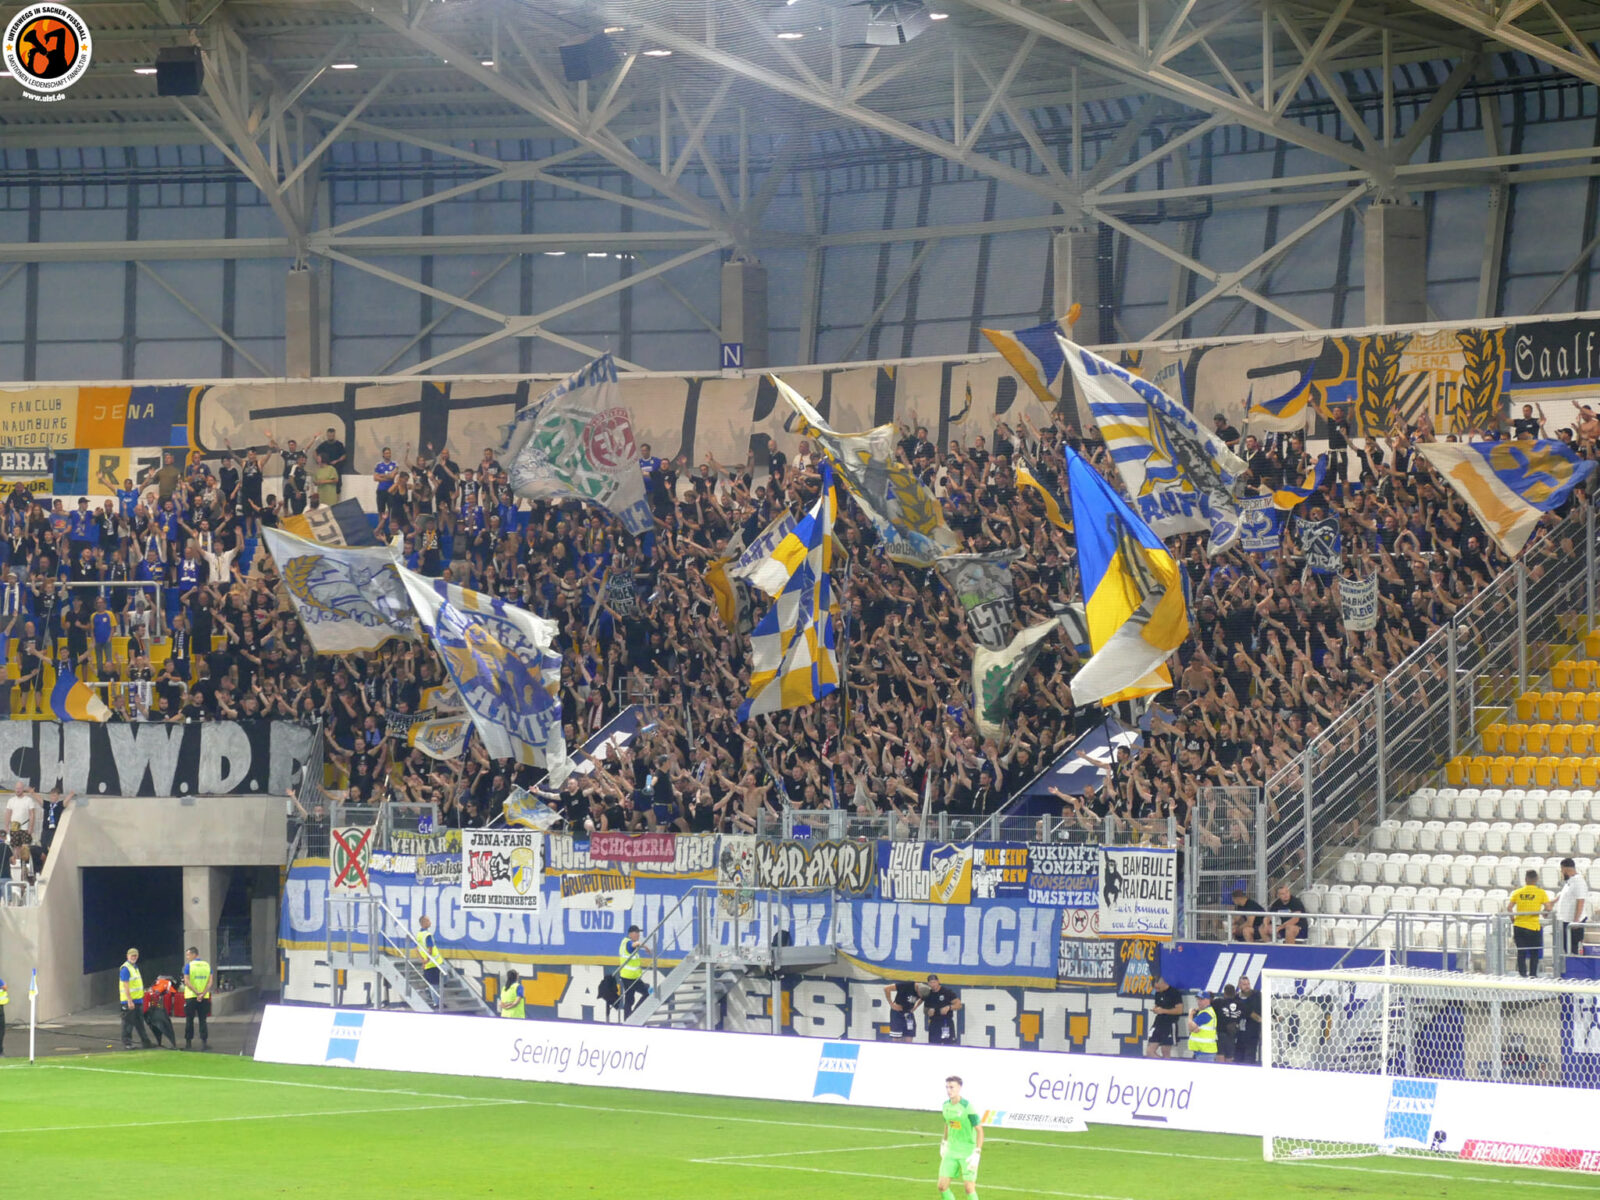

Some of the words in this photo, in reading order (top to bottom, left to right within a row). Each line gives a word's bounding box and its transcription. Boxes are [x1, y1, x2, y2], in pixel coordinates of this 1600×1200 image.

[724, 345, 741, 366] N
[1410, 354, 1450, 368] JENA
[1515, 331, 1600, 381] Saalf
[11, 400, 31, 414] FAN
[35, 398, 62, 411] CLUB
[1436, 381, 1456, 416] FC
[93, 402, 155, 421] JENA
[2, 417, 67, 432] NAUMBURG
[0, 433, 38, 447] UNITED
[40, 432, 68, 445] CITYS
[391, 837, 448, 855] WEIMAR
[471, 833, 532, 847] JENA-FANS
[590, 837, 674, 857] SCHICKERIA
[1032, 861, 1099, 876] KONZEPT
[1122, 856, 1174, 878] BAMBULE
[1030, 876, 1099, 890] KONSEQUENT
[1122, 878, 1173, 901] RANDALE
[464, 893, 487, 904] GEGEN
[581, 911, 615, 931] UND
[1060, 940, 1115, 960] REFUGEES
[1058, 959, 1115, 979] WELCOME
[1127, 963, 1136, 974] IN
[1136, 963, 1150, 976] DIE
[511, 1037, 572, 1073] Seeing
[577, 1041, 648, 1076] beyond
[819, 1058, 858, 1074] ZEISS
[1025, 1072, 1100, 1111] Seeing
[1107, 1075, 1194, 1113] beyond
